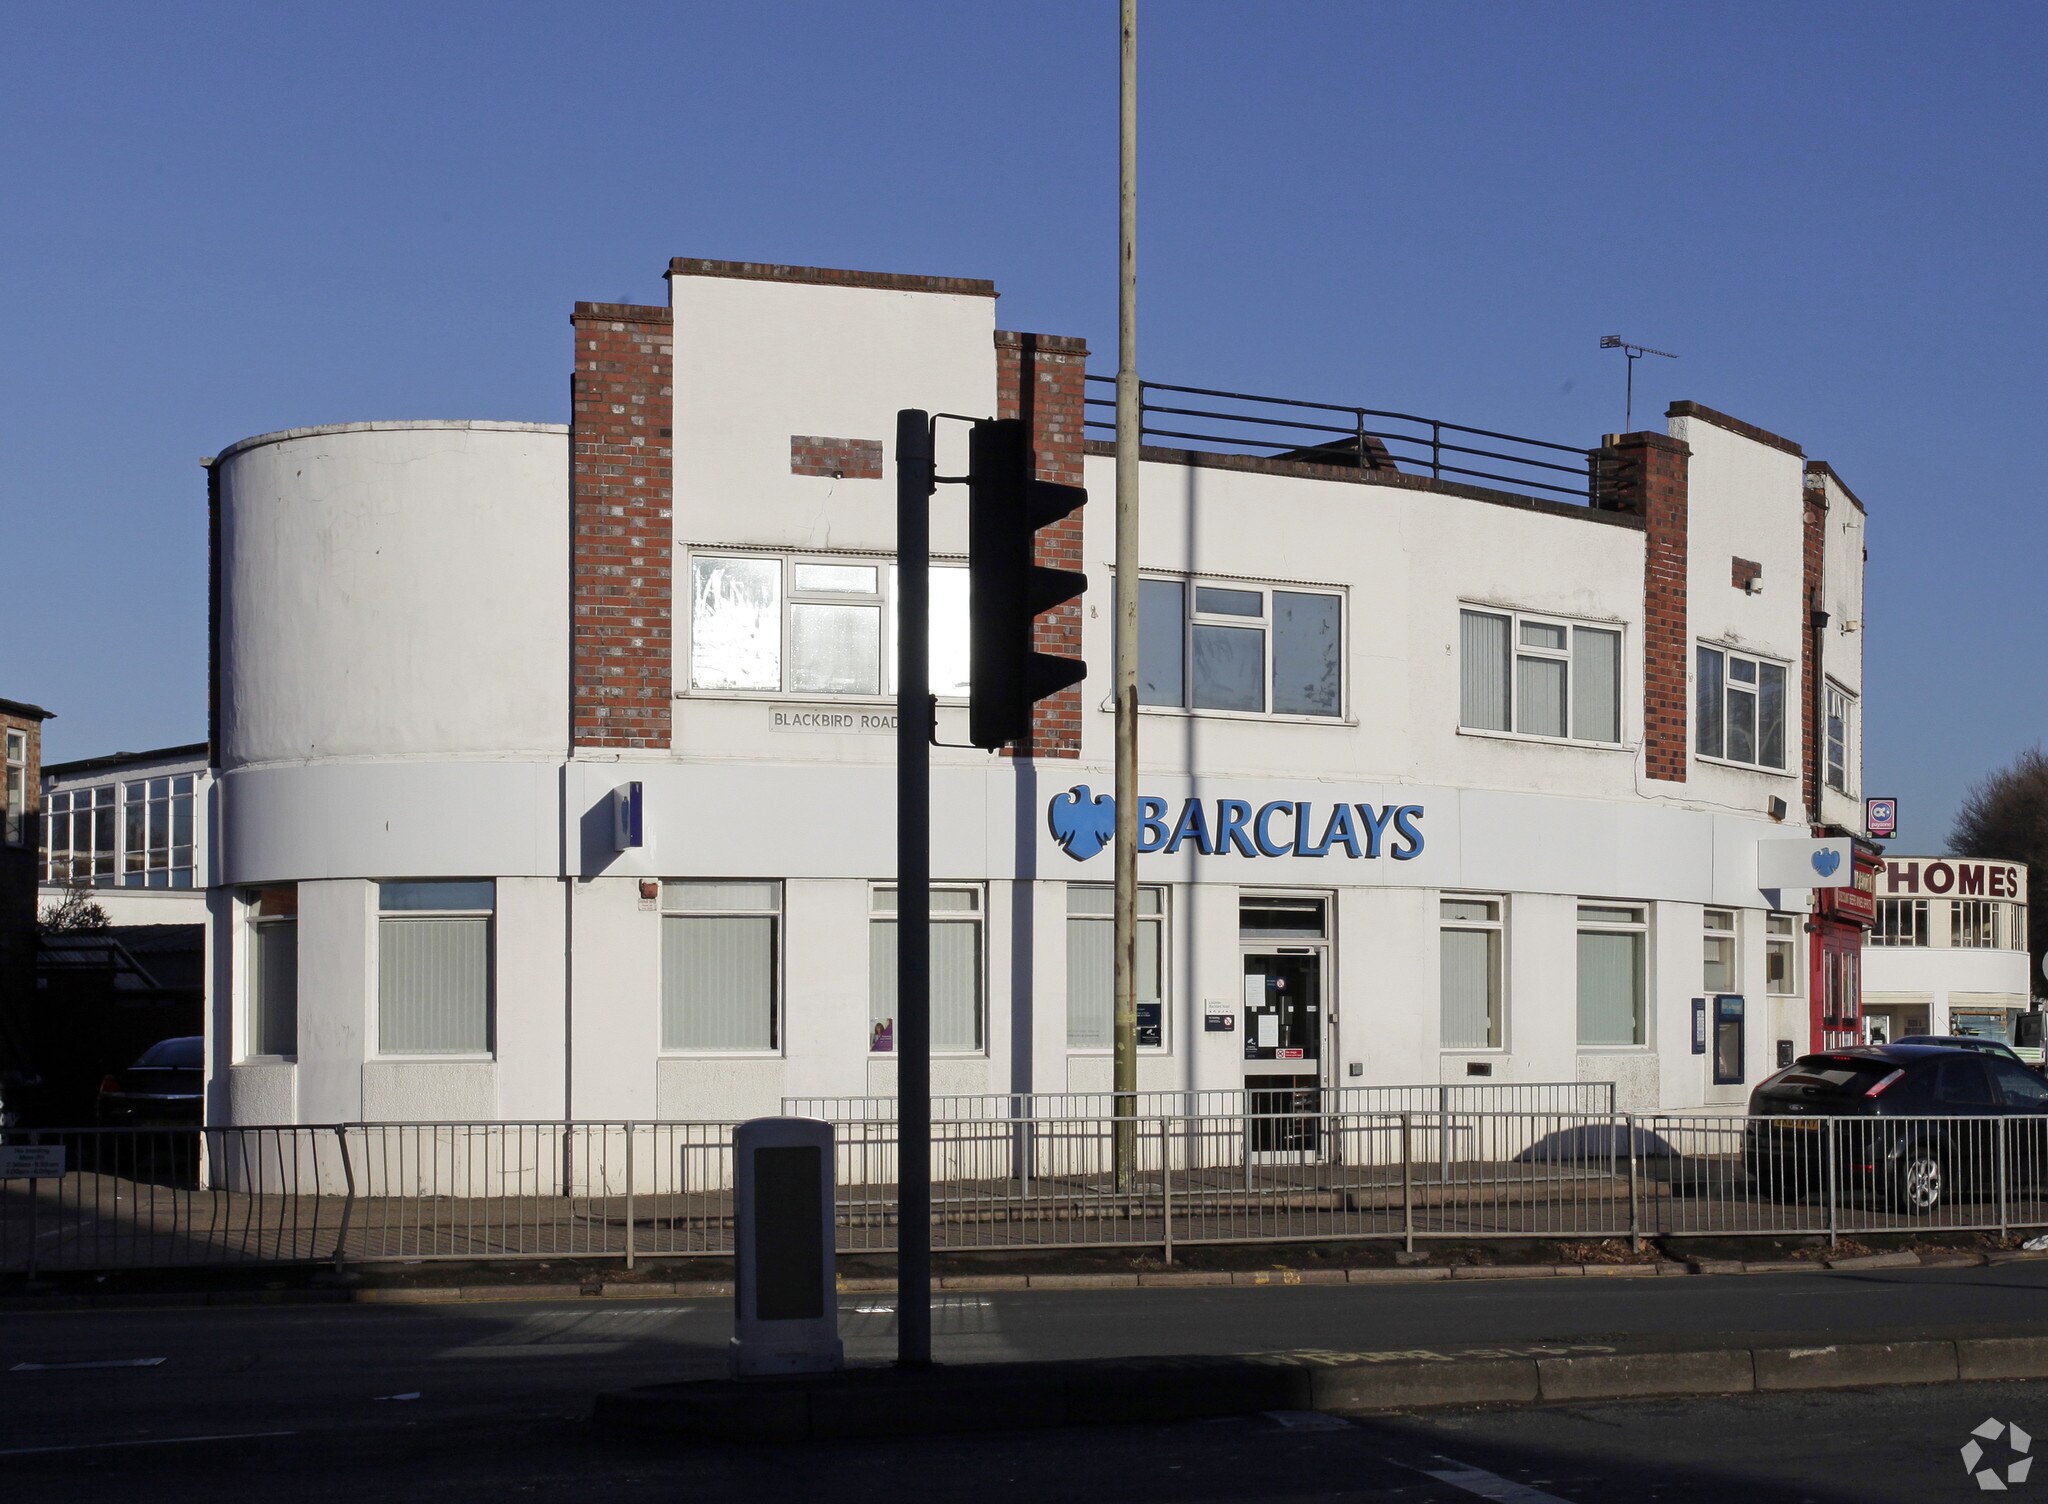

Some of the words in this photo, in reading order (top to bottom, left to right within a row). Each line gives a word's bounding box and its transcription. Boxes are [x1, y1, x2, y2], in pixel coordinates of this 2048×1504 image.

[774, 712, 853, 728] BLACKBIRD
[860, 715, 898, 729] ROAD
[1137, 795, 1425, 861] BARCLAYS
[1887, 862, 2018, 898] HOMES
